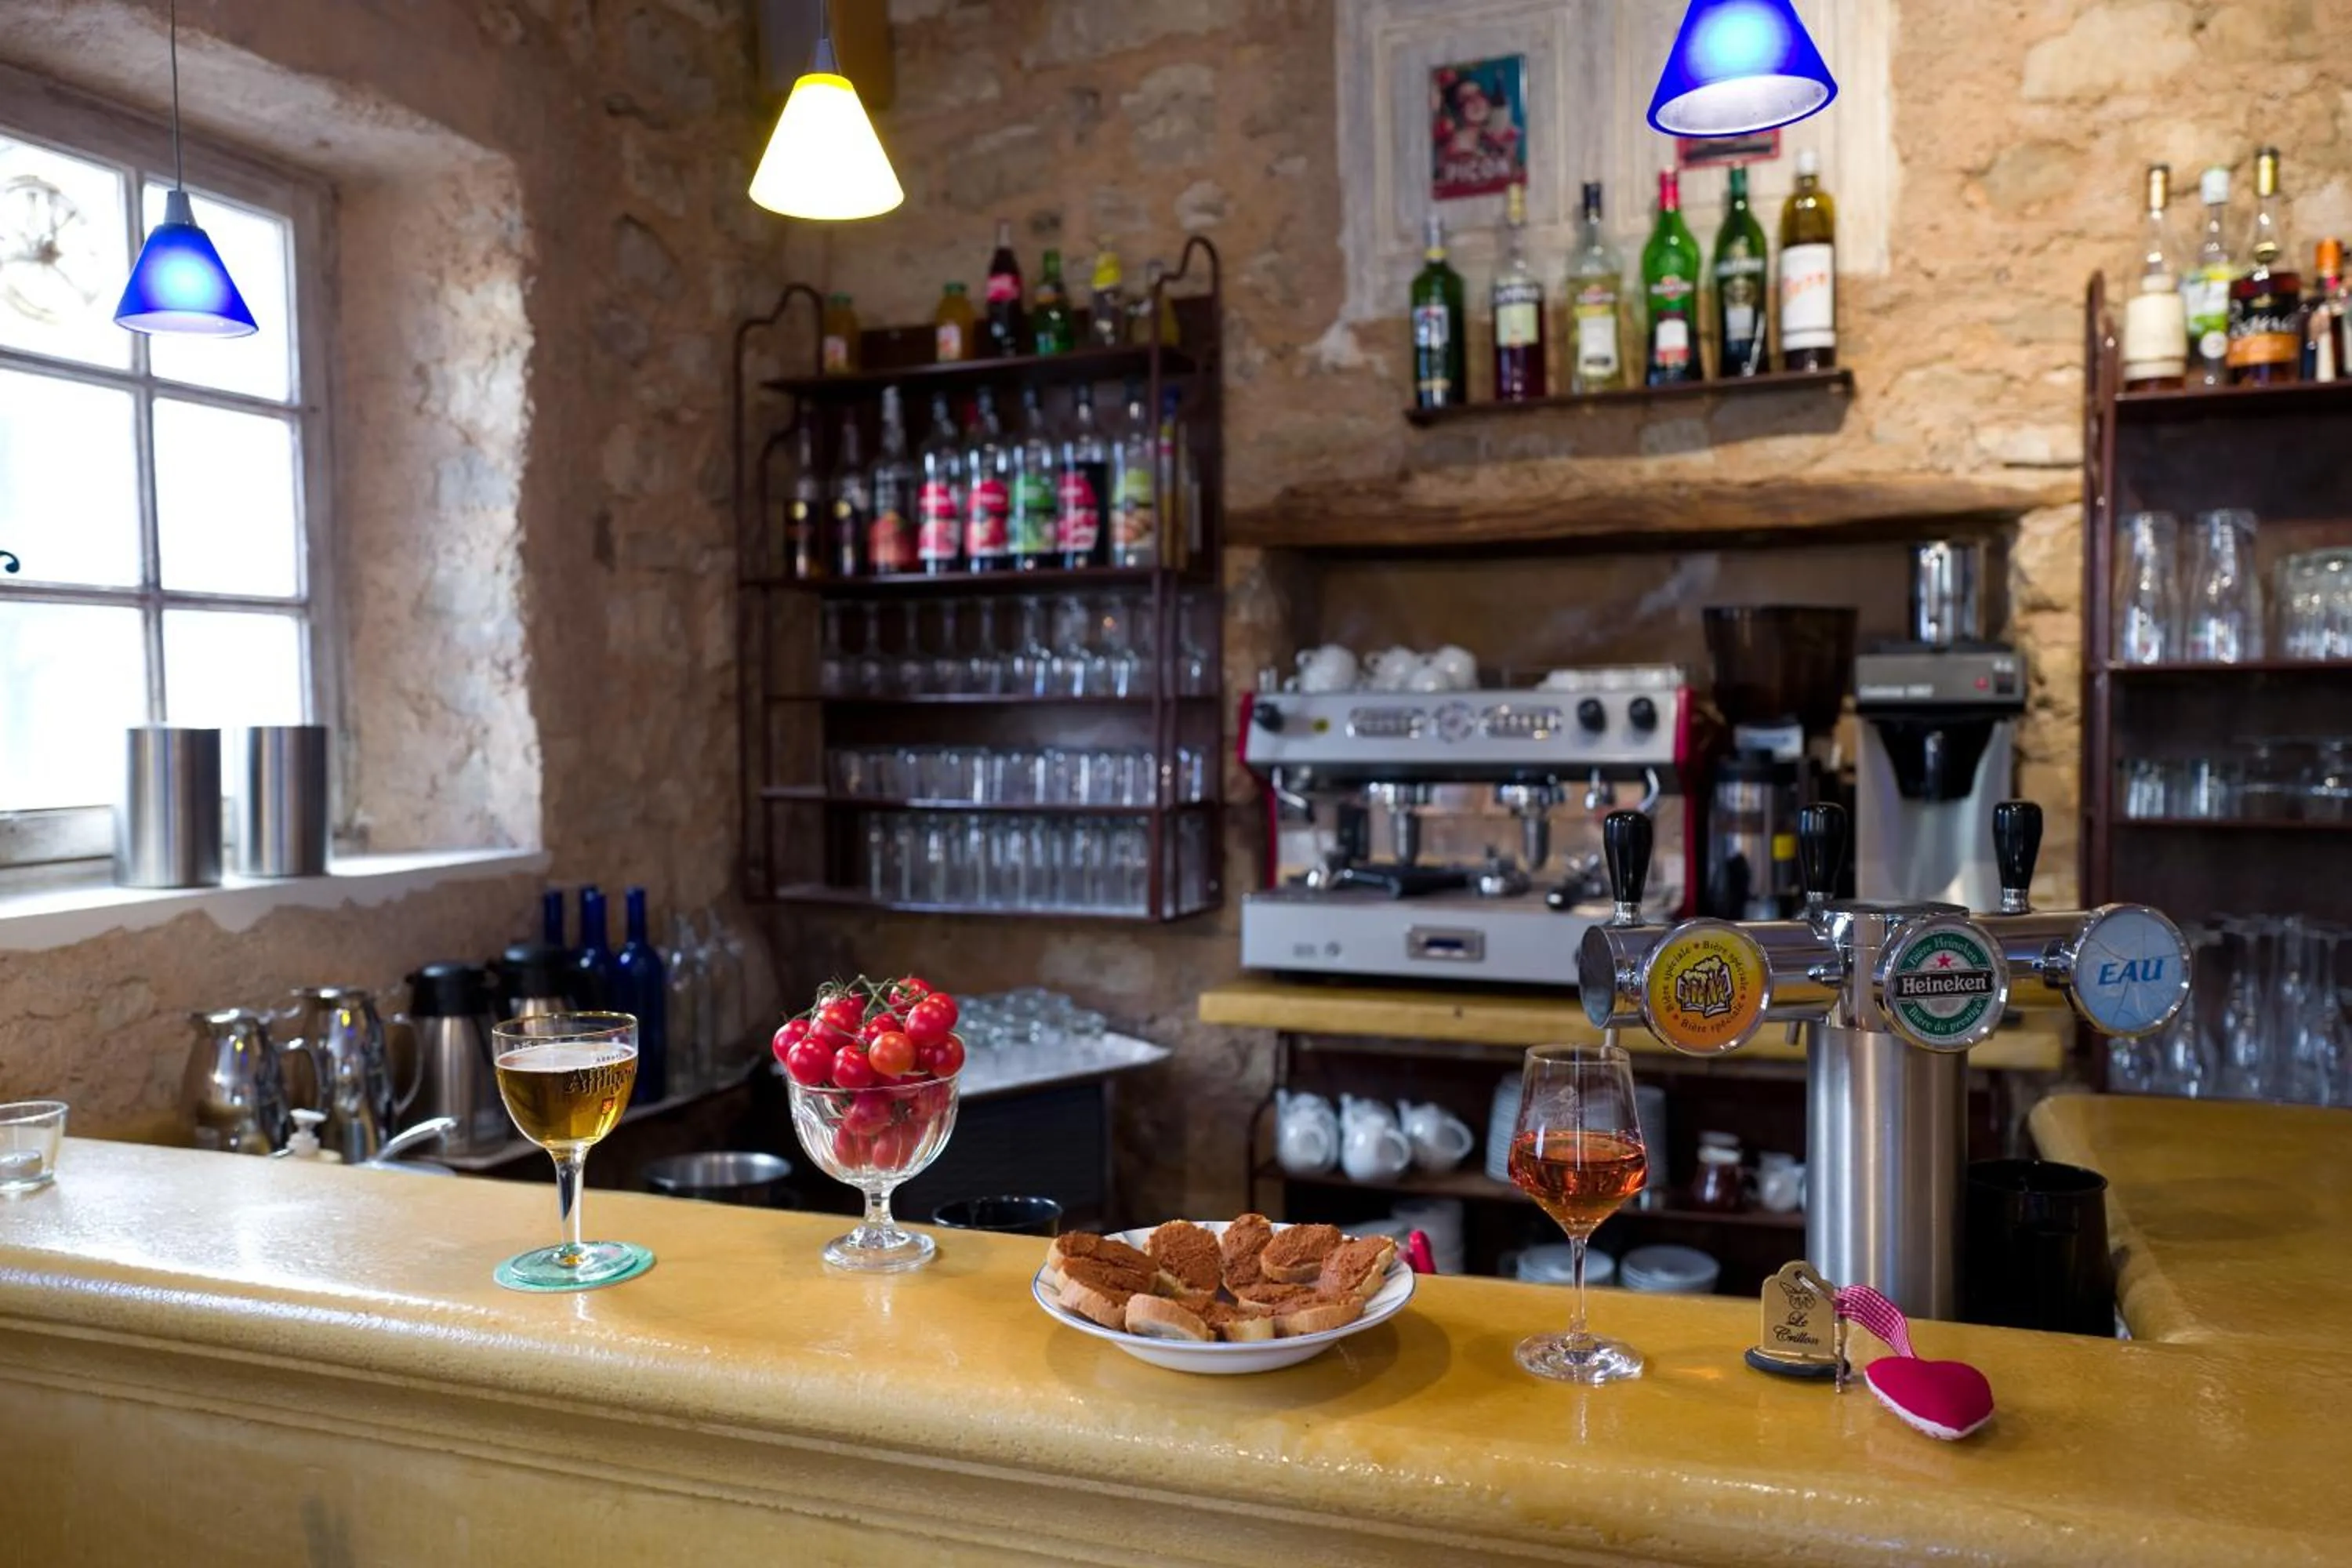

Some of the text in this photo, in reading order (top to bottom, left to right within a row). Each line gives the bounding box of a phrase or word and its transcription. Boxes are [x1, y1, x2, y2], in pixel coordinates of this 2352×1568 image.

[2098, 958, 2165, 985] EAU
[1902, 975, 1987, 994] Heineken
[1787, 1310, 1809, 1327] Le
[1773, 1325, 1819, 1345] Crillon
